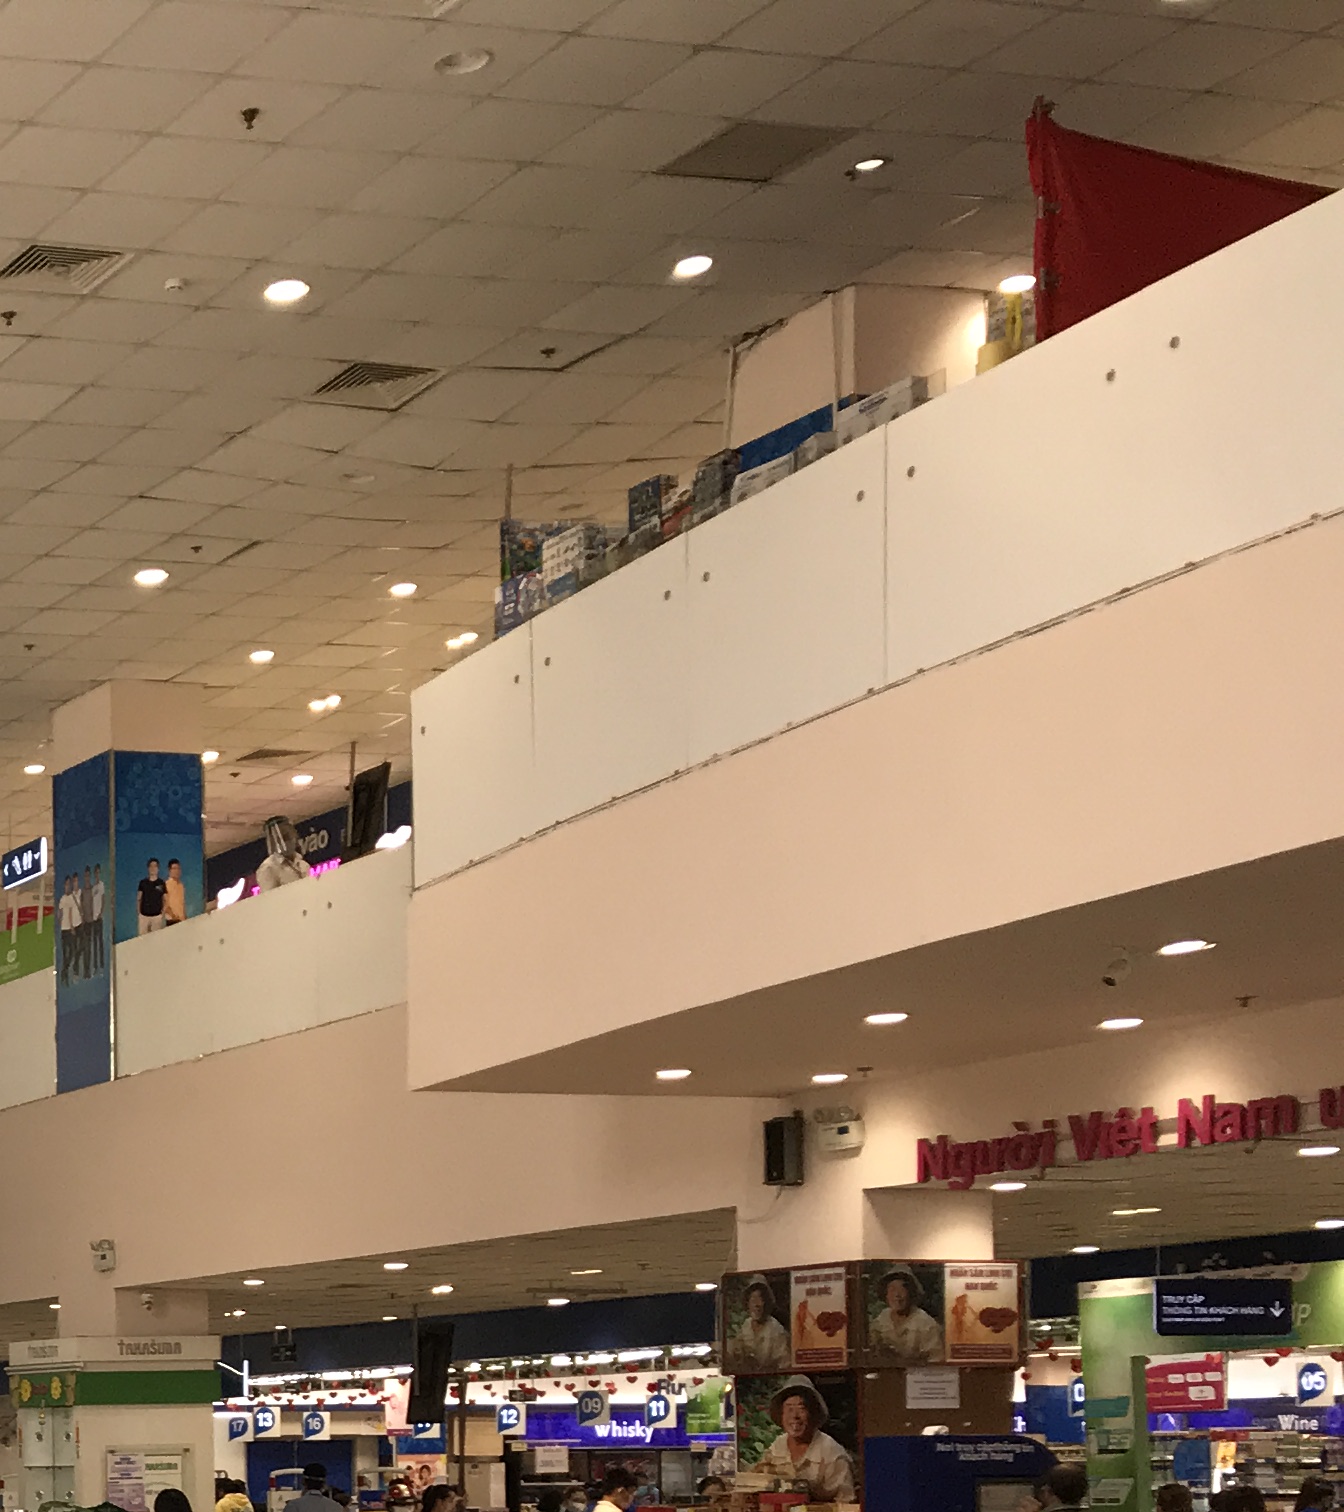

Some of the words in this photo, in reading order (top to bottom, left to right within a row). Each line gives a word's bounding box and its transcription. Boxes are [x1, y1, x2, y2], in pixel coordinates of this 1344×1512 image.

[1178, 1095, 1301, 1148] Nam
[1301, 1371, 1326, 1391] 05
[582, 1397, 602, 1413] 09
[649, 1400, 665, 1416] 11
[257, 1412, 273, 1427] 13
[307, 1417, 321, 1430] 16
[500, 1409, 518, 1424] 12
[1277, 1414, 1319, 1431] Wine
[231, 1420, 246, 1432] 17
[595, 1421, 654, 1443] whisky
